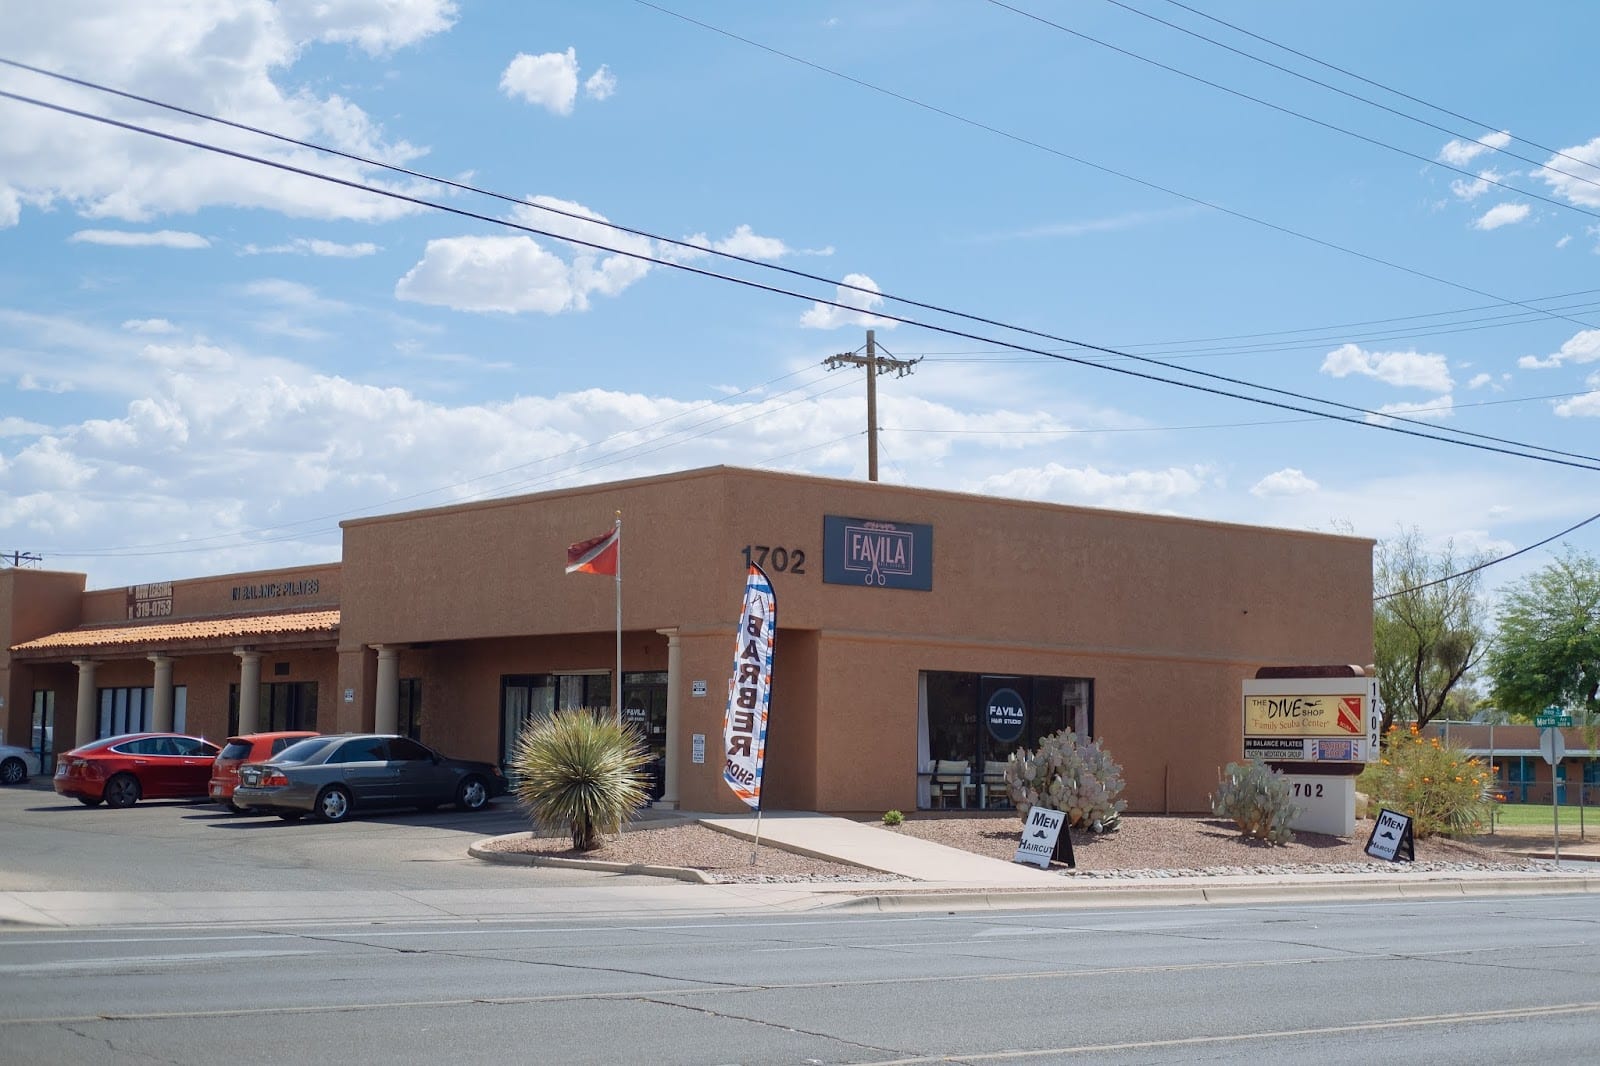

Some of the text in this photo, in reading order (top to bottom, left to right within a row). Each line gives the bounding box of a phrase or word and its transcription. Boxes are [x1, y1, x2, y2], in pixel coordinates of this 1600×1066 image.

[852, 534, 906, 564] FAVILA
[742, 545, 806, 574] 1702
[243, 583, 281, 599] BALANCE
[282, 579, 319, 597] PILATES
[136, 600, 171, 618] 319-0753
[989, 706, 1023, 717] FAVILA
[1268, 698, 1302, 719] DIVE
[1280, 720, 1300, 729] Scuba
[1536, 717, 1556, 727] Martin
[1280, 740, 1303, 748] PILATES
